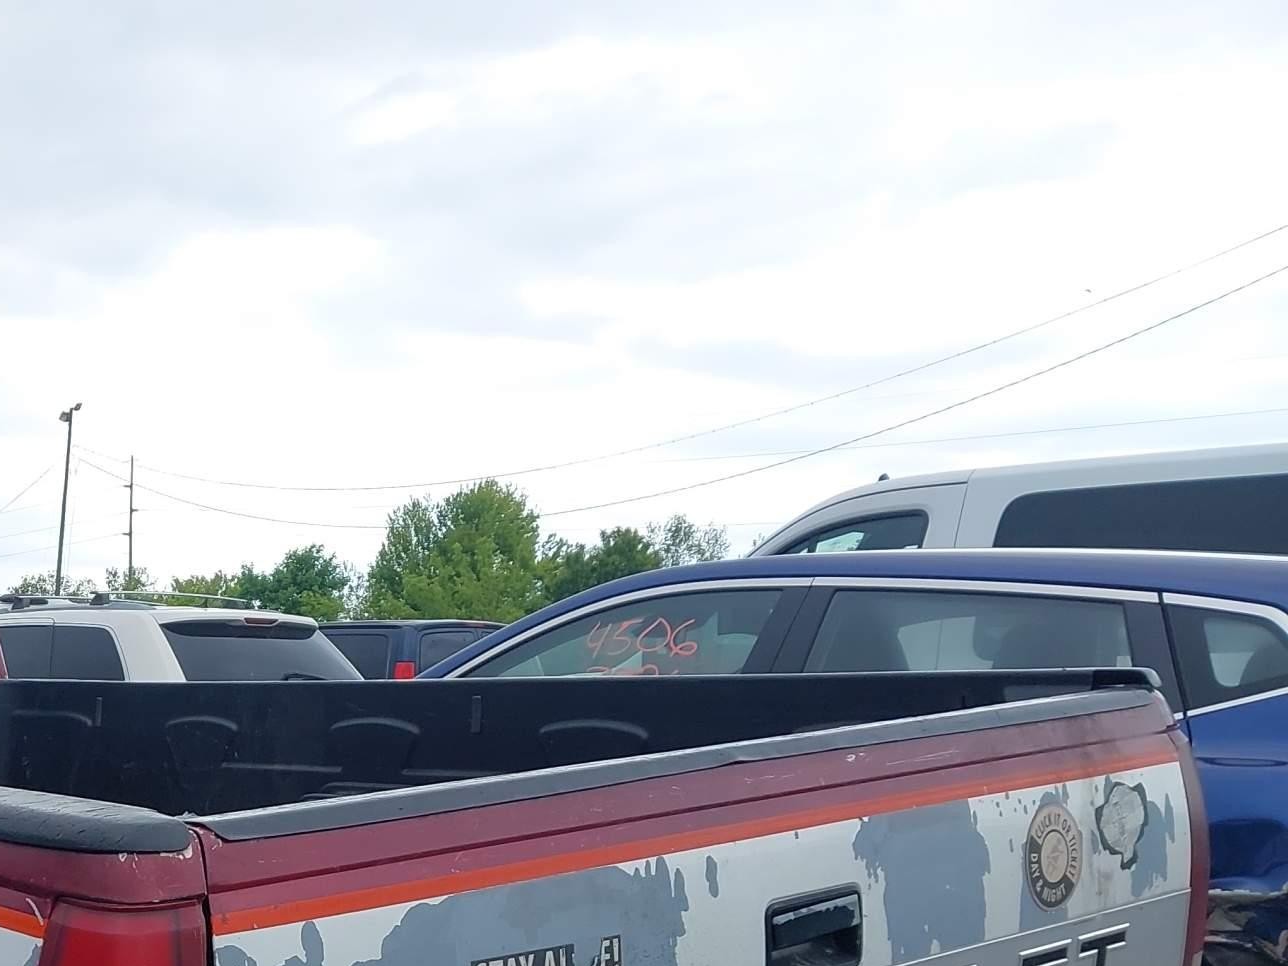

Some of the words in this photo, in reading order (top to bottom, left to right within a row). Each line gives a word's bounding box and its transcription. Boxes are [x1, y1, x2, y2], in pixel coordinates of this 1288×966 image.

[587, 617, 698, 658] 4506
[1053, 812, 1061, 827] IT
[1062, 818, 1072, 837] OR
[1030, 853, 1041, 879] DAY
[1041, 883, 1066, 903] NIGHT
